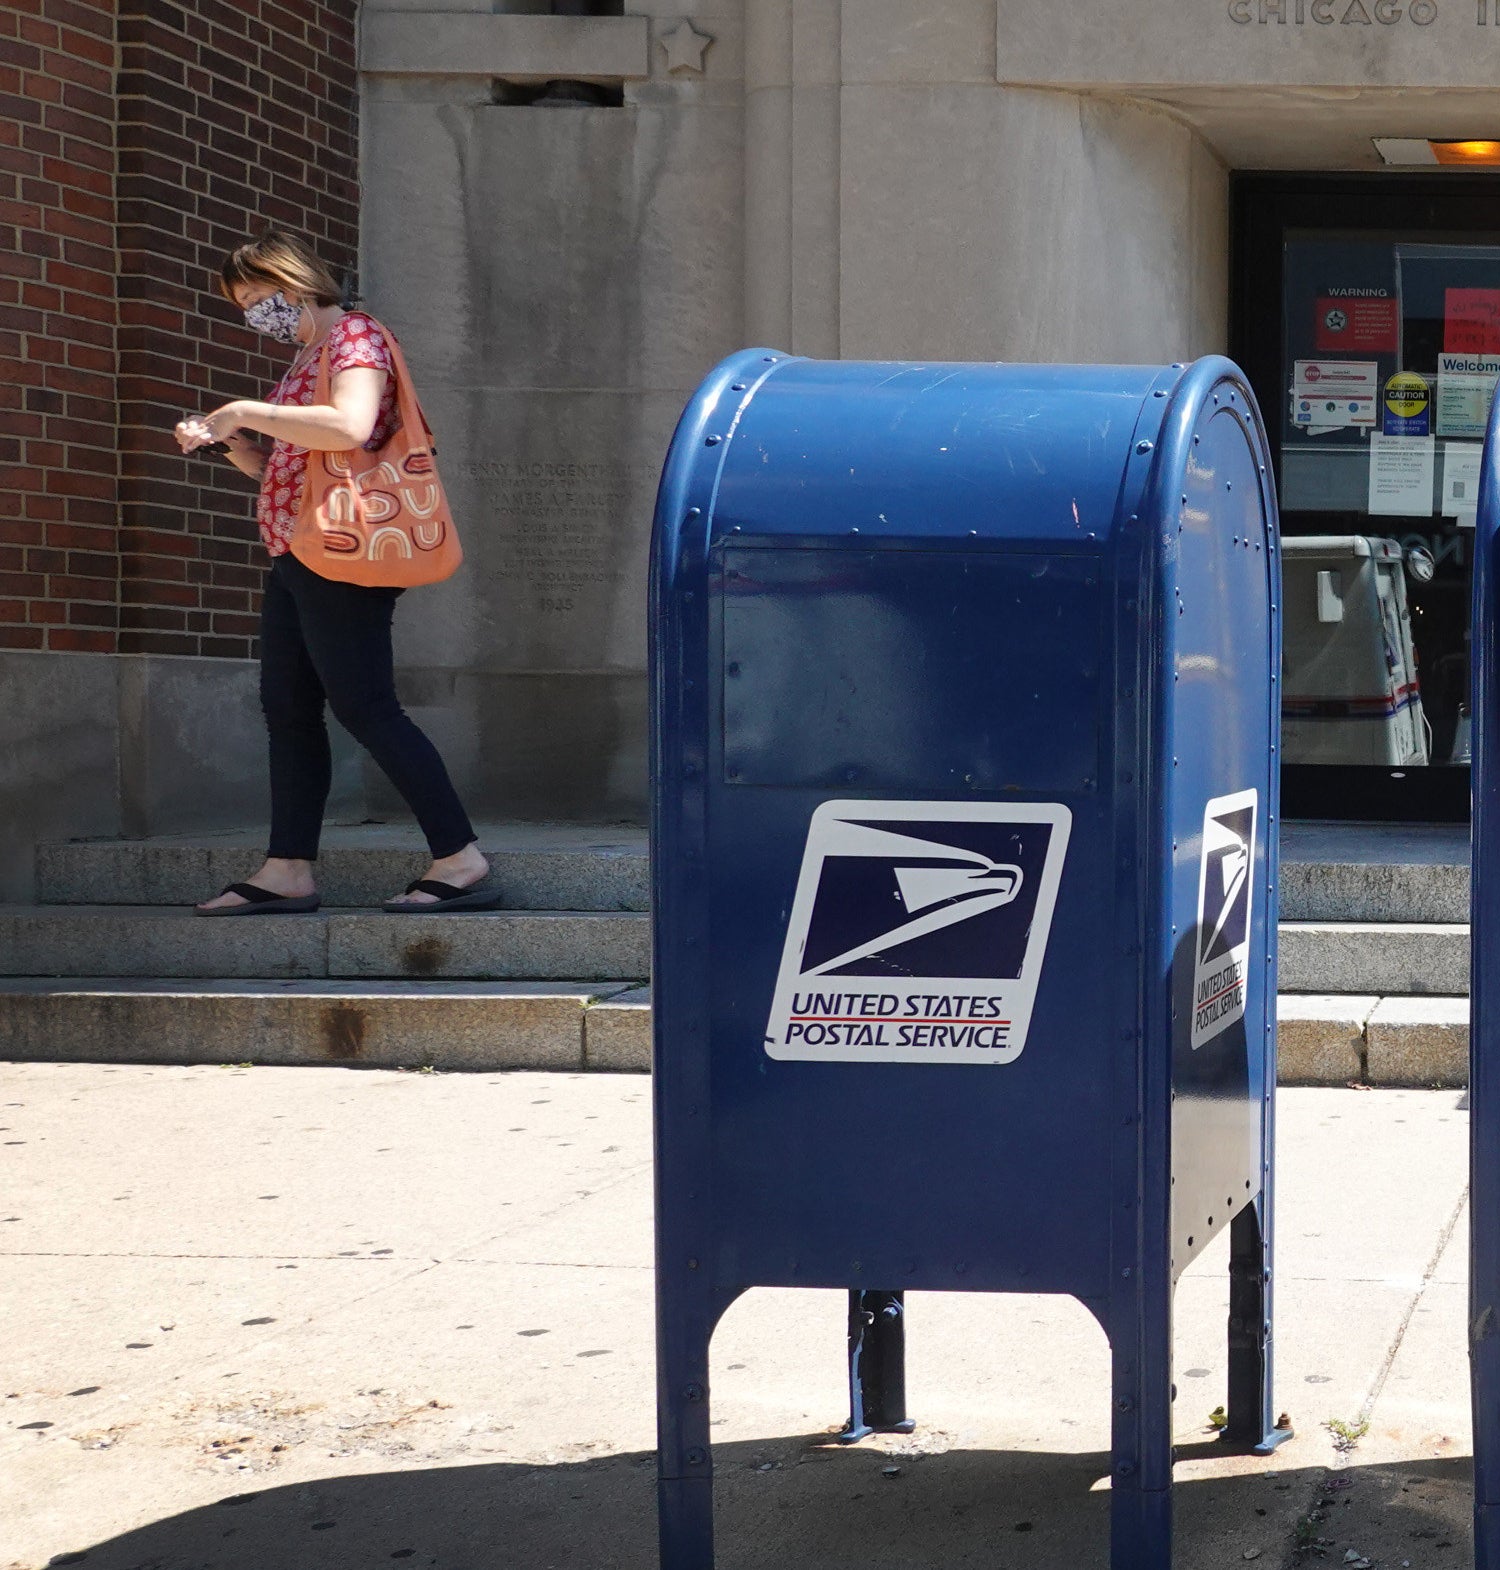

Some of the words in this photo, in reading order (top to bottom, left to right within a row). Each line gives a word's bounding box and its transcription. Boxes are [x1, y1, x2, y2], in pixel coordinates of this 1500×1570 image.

[1227, 0, 1438, 25] CHICAGO
[1328, 287, 1388, 298] WARNING
[1389, 391, 1425, 399] CAUTION
[1197, 971, 1224, 1003] UNITED
[1221, 959, 1243, 989] STATES
[792, 993, 898, 1017] UNITED
[903, 995, 1003, 1018] STATES
[1195, 1000, 1219, 1033] POSTAL
[1219, 984, 1243, 1017] SERVICE
[785, 1023, 889, 1046] POSTAL
[896, 1025, 1010, 1049] SERVICE
